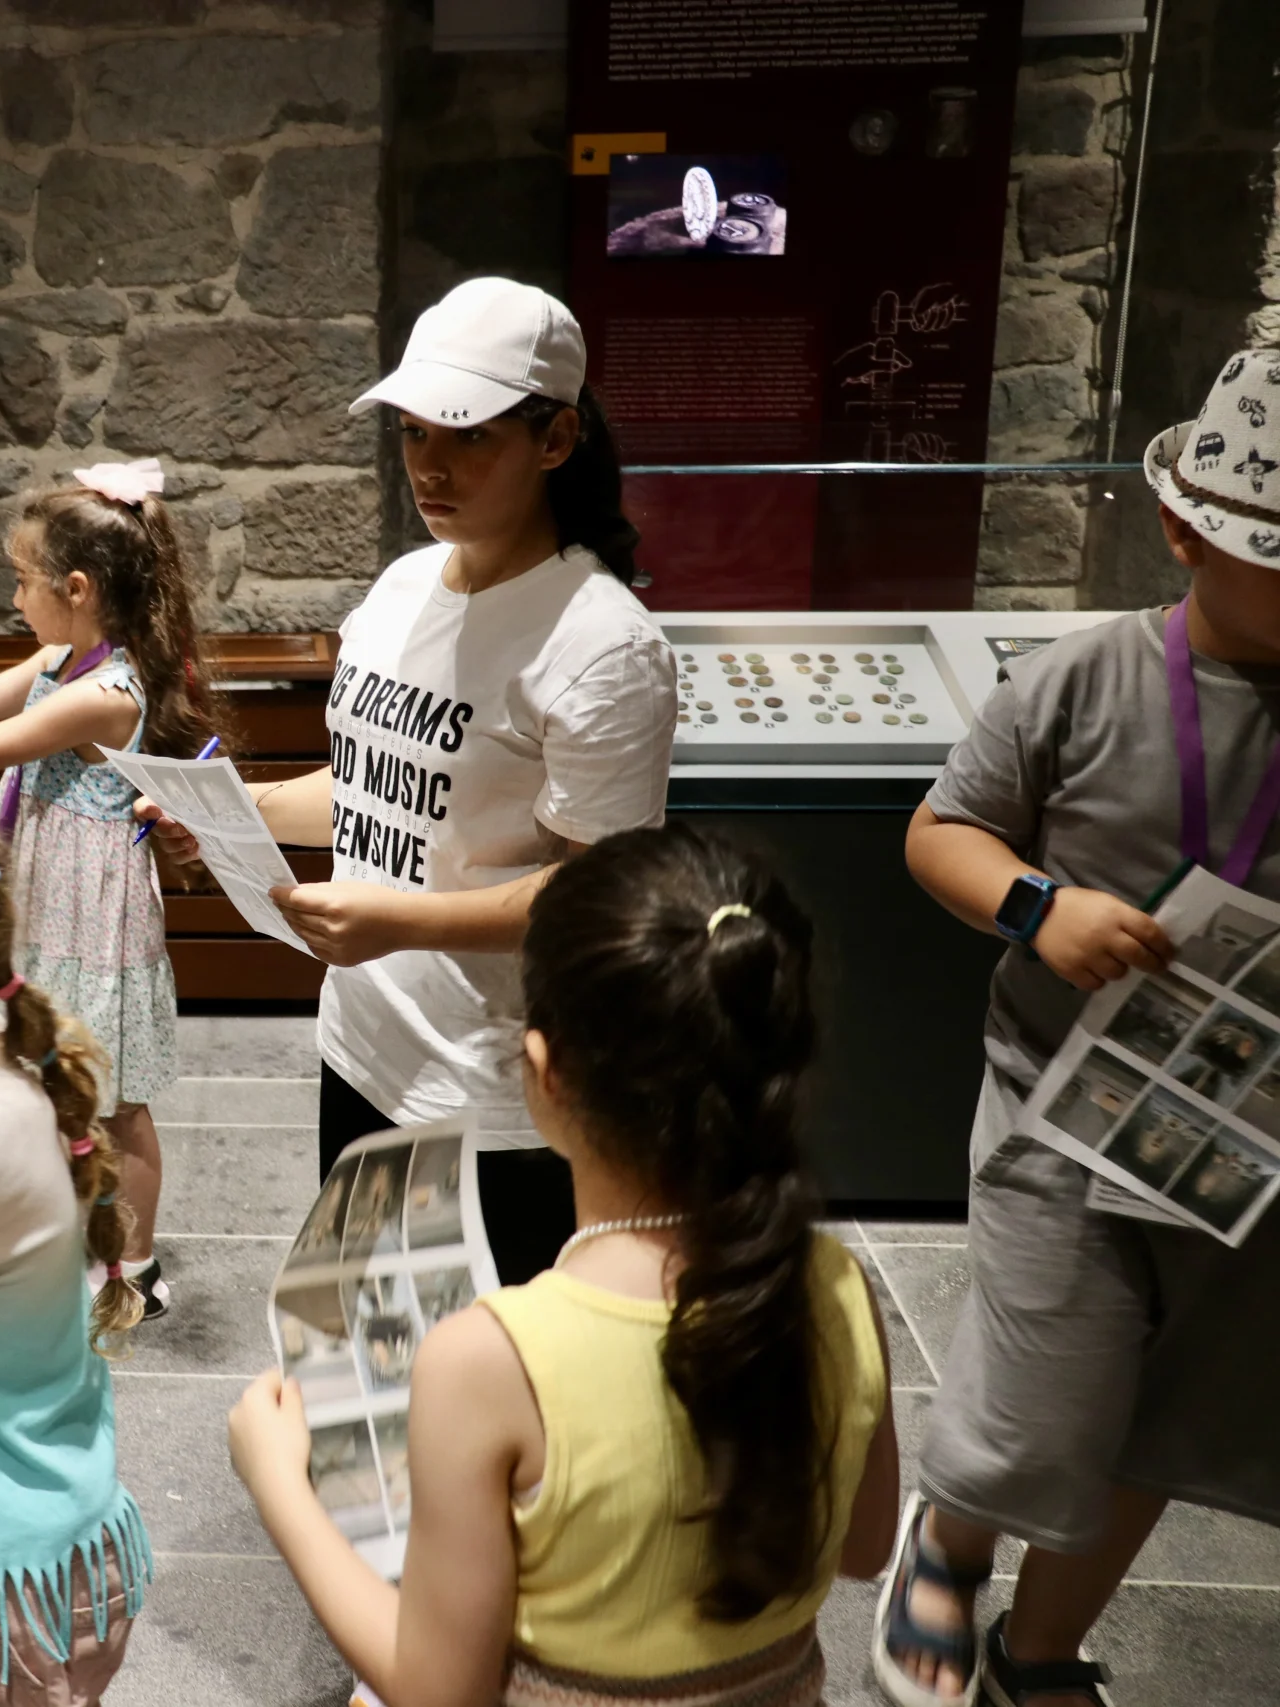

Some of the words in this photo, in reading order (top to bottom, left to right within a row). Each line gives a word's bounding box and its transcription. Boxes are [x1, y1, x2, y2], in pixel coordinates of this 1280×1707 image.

[350, 671, 474, 754] DREAMS
[331, 730, 357, 785] OD
[363, 745, 452, 822] MUSIC
[331, 798, 426, 886] PENSIVE
